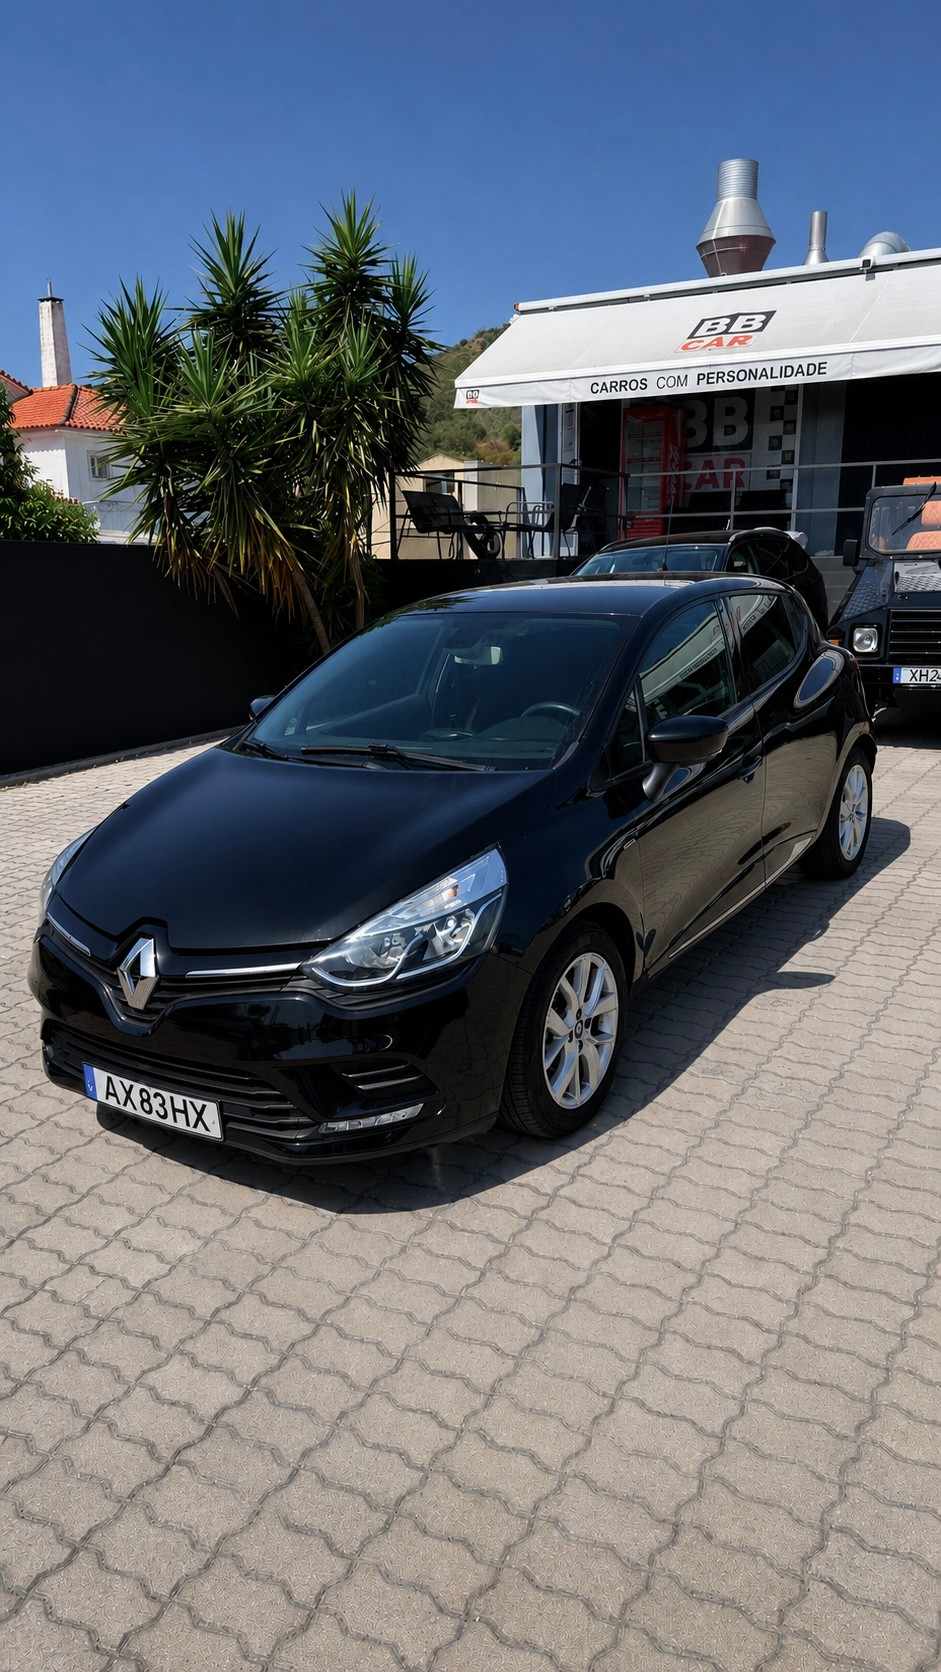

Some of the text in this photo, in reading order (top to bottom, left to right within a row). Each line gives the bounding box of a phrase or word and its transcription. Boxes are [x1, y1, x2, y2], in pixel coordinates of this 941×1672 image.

[691, 312, 768, 338] BB
[680, 334, 753, 352] CAR
[590, 361, 828, 394] CARROS COM PERSONALIDADE
[685, 456, 746, 491] AR
[105, 1075, 211, 1133] AX83HX
